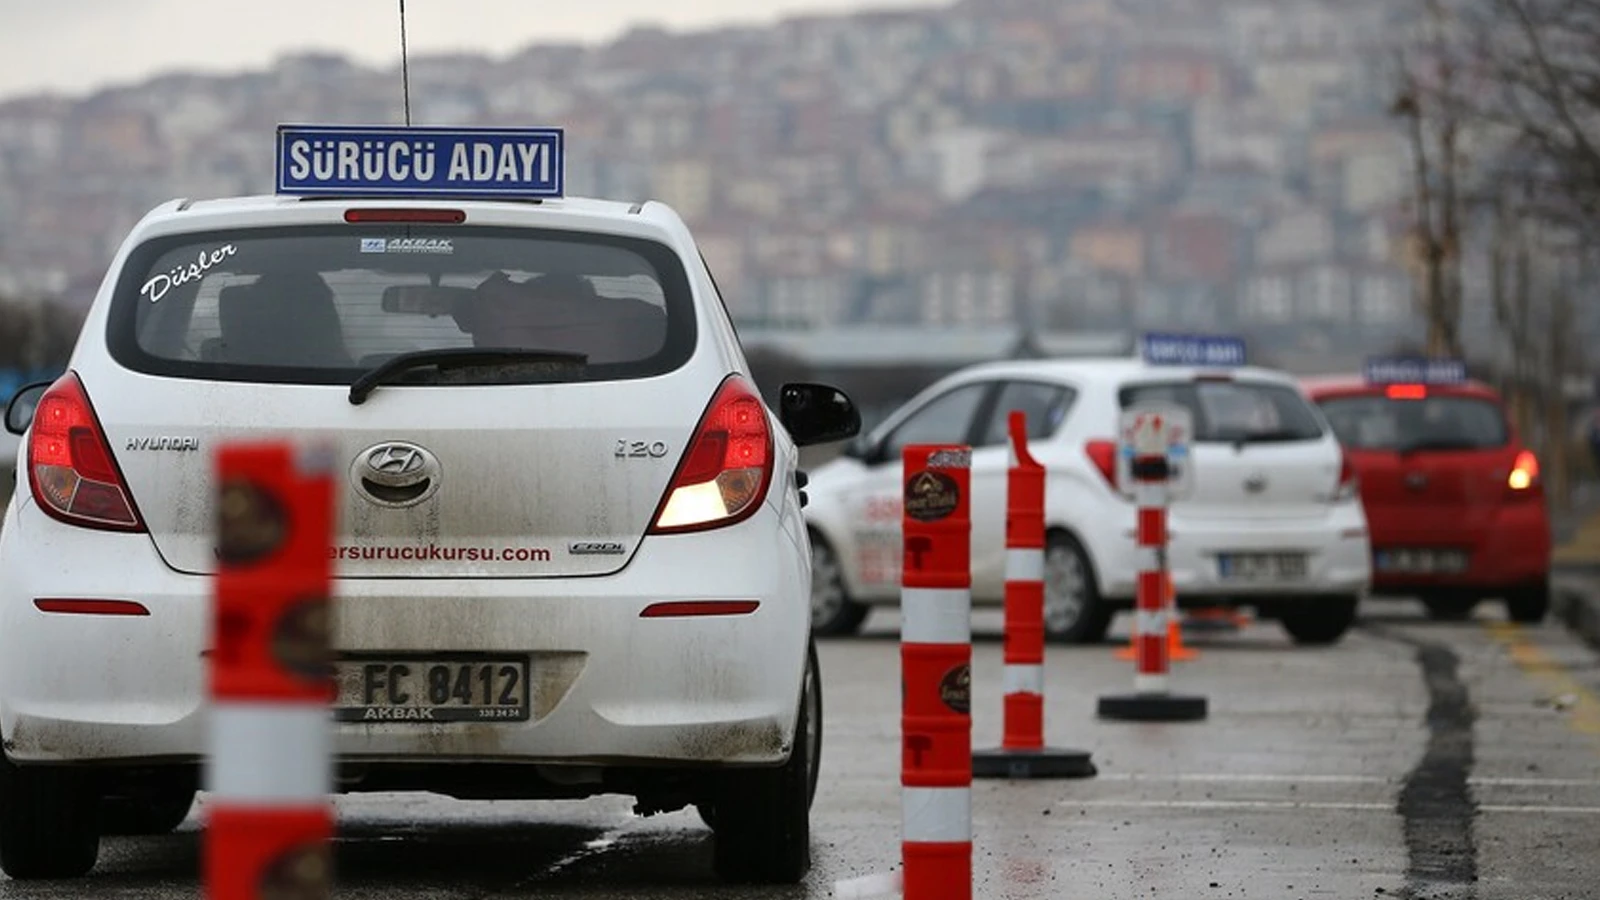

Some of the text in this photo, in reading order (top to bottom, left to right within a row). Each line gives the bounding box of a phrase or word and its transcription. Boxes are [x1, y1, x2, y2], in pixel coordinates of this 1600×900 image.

[289, 139, 550, 183] SÜRÜCÜ ADAYI
[140, 244, 237, 302] Düşler
[124, 436, 199, 451] HYUNDAI
[213, 544, 551, 562] ersurucukursu.com
[364, 664, 519, 706] FC 8412
[363, 707, 434, 720] AKBAK
